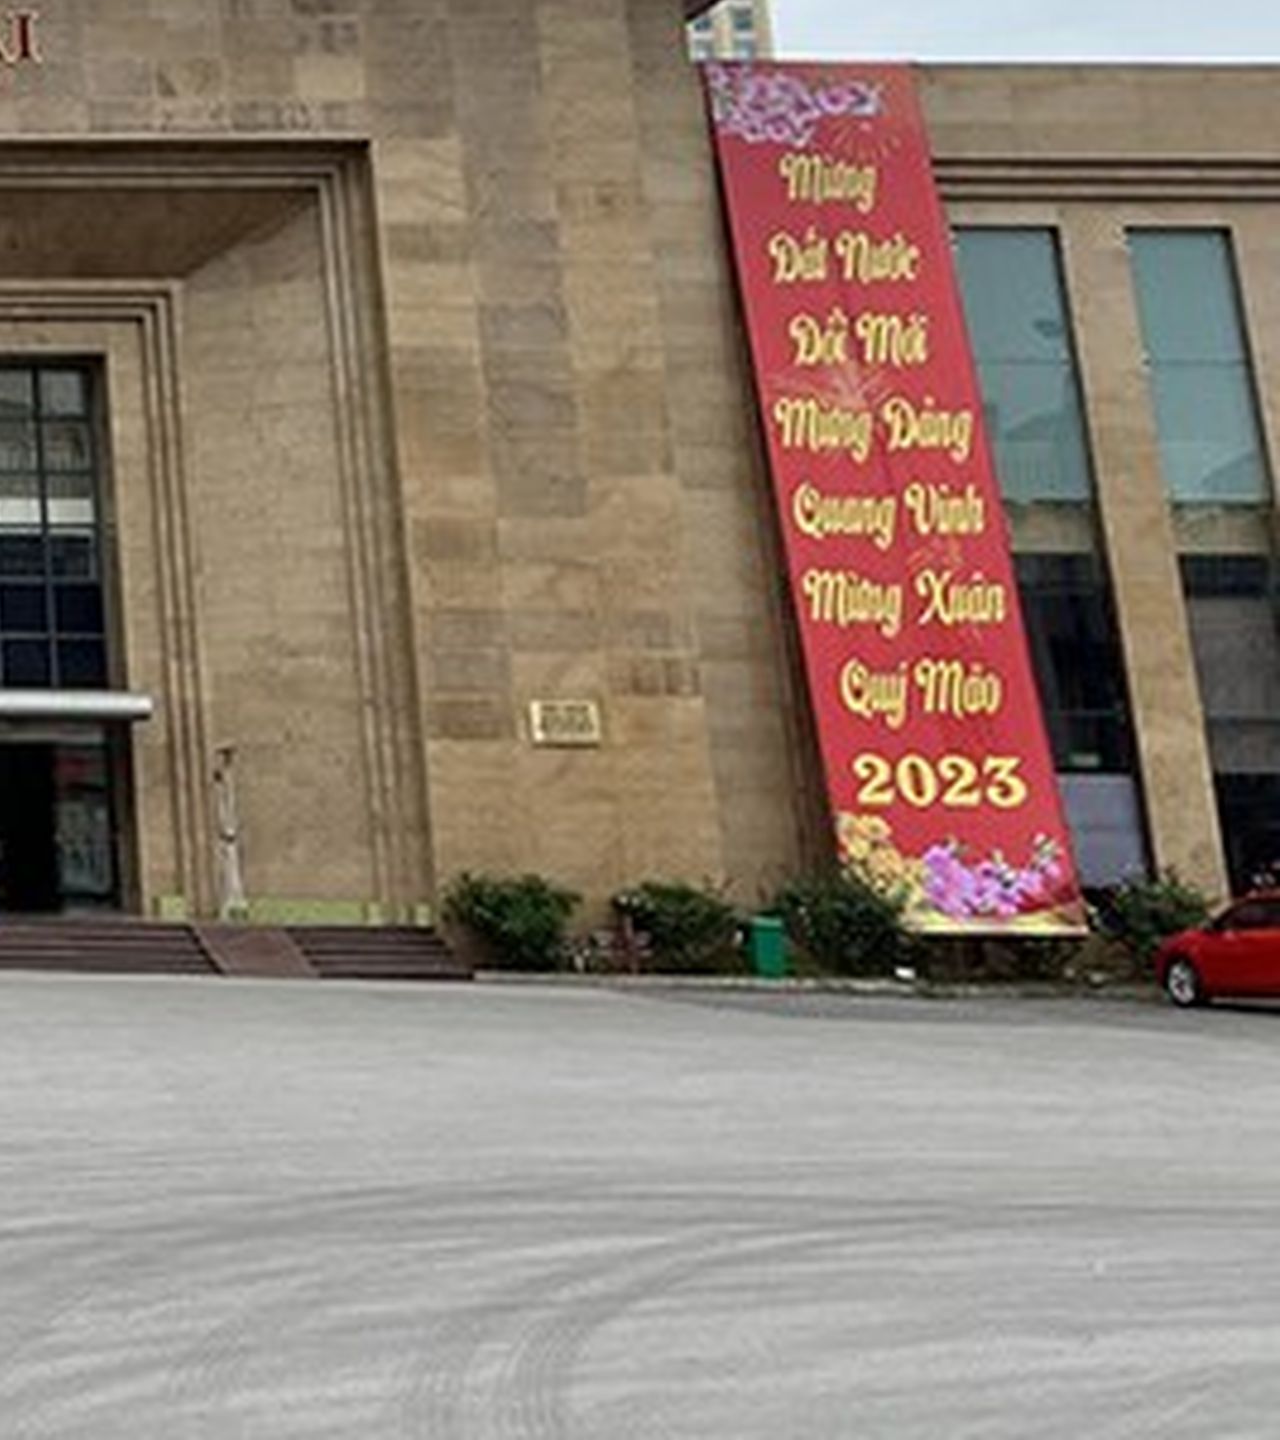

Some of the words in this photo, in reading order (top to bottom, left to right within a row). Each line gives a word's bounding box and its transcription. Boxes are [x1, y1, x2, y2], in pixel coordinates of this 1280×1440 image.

[793, 481, 896, 551] Quang
[803, 567, 902, 638] Mừng
[914, 568, 1006, 626] Xuân
[840, 658, 908, 730] Quý
[852, 752, 1027, 809] 2023
